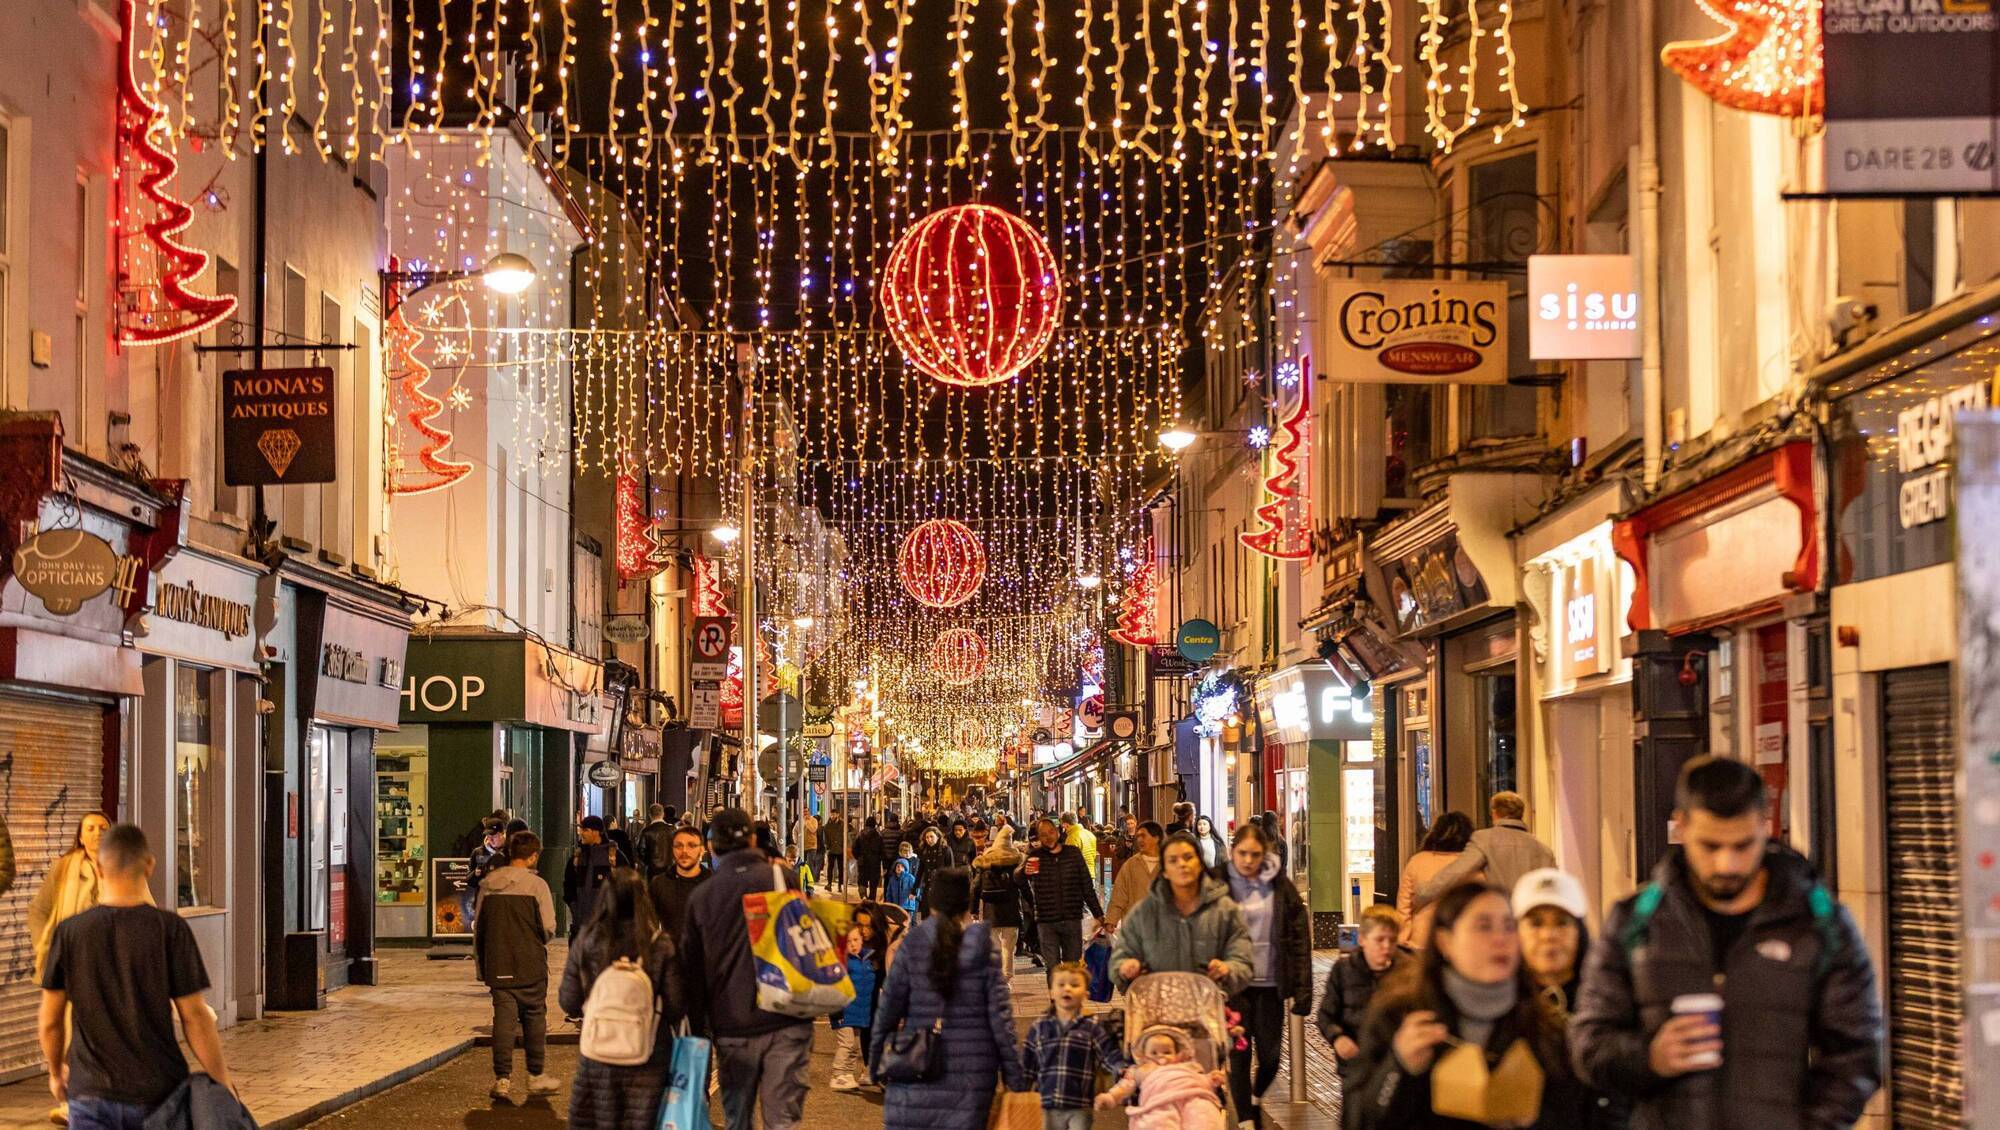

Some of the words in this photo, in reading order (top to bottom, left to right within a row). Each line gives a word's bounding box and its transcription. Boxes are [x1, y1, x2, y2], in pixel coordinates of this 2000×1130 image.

[1824, 16, 1884, 33] GREAT
[1887, 14, 1995, 32] OUTDOORS
[1844, 147, 1915, 171] DARE
[1920, 147, 1954, 170] 2B
[1387, 351, 1476, 365] MENSWEAR
[233, 376, 325, 396] MONA'S
[231, 402, 328, 420] ANTIQUES
[38, 562, 60, 570] JOHN
[63, 561, 84, 570] DALY
[26, 571, 105, 586] OPTICIANS
[56, 598, 72, 610] 77
[1183, 635, 1214, 644] Centra
